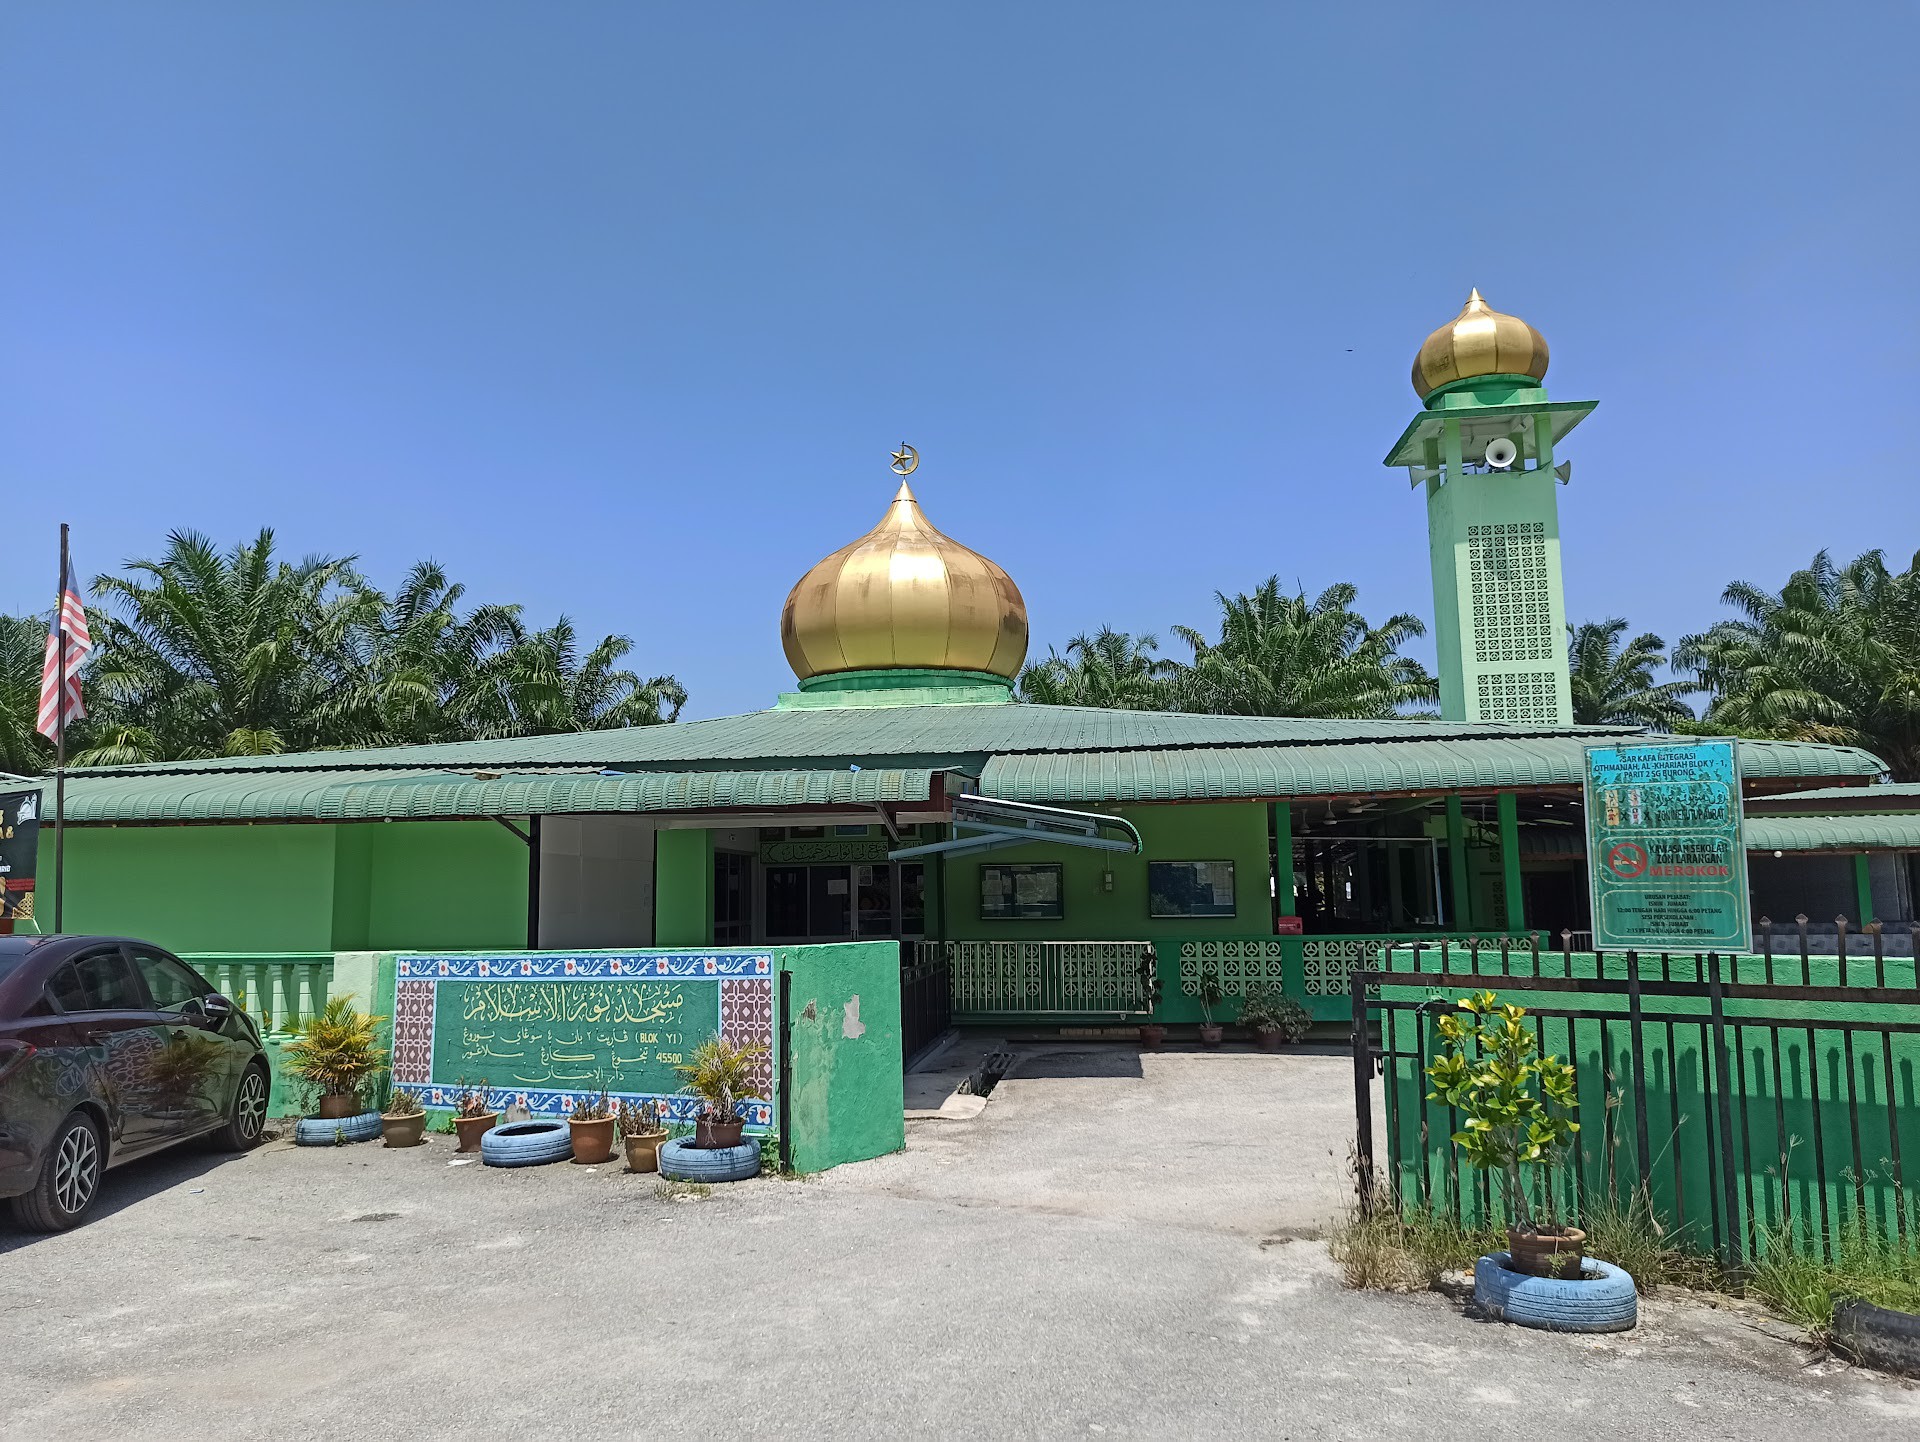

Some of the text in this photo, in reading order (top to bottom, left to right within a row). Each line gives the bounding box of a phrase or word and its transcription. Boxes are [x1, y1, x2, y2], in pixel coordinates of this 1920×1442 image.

[1637, 754, 1657, 763] KAFA
[1657, 752, 1696, 762] INTEGRASI
[1689, 760, 1707, 768] BLOK
[1623, 771, 1644, 779] PARIT
[1649, 843, 1728, 854] KAWASAN SEKOLAH
[1656, 853, 1722, 864] ZON LARANGAN
[1649, 865, 1729, 877] MEROKOK
[635, 1032, 658, 1044] (BLOK
[656, 1052, 683, 1064] 45500
